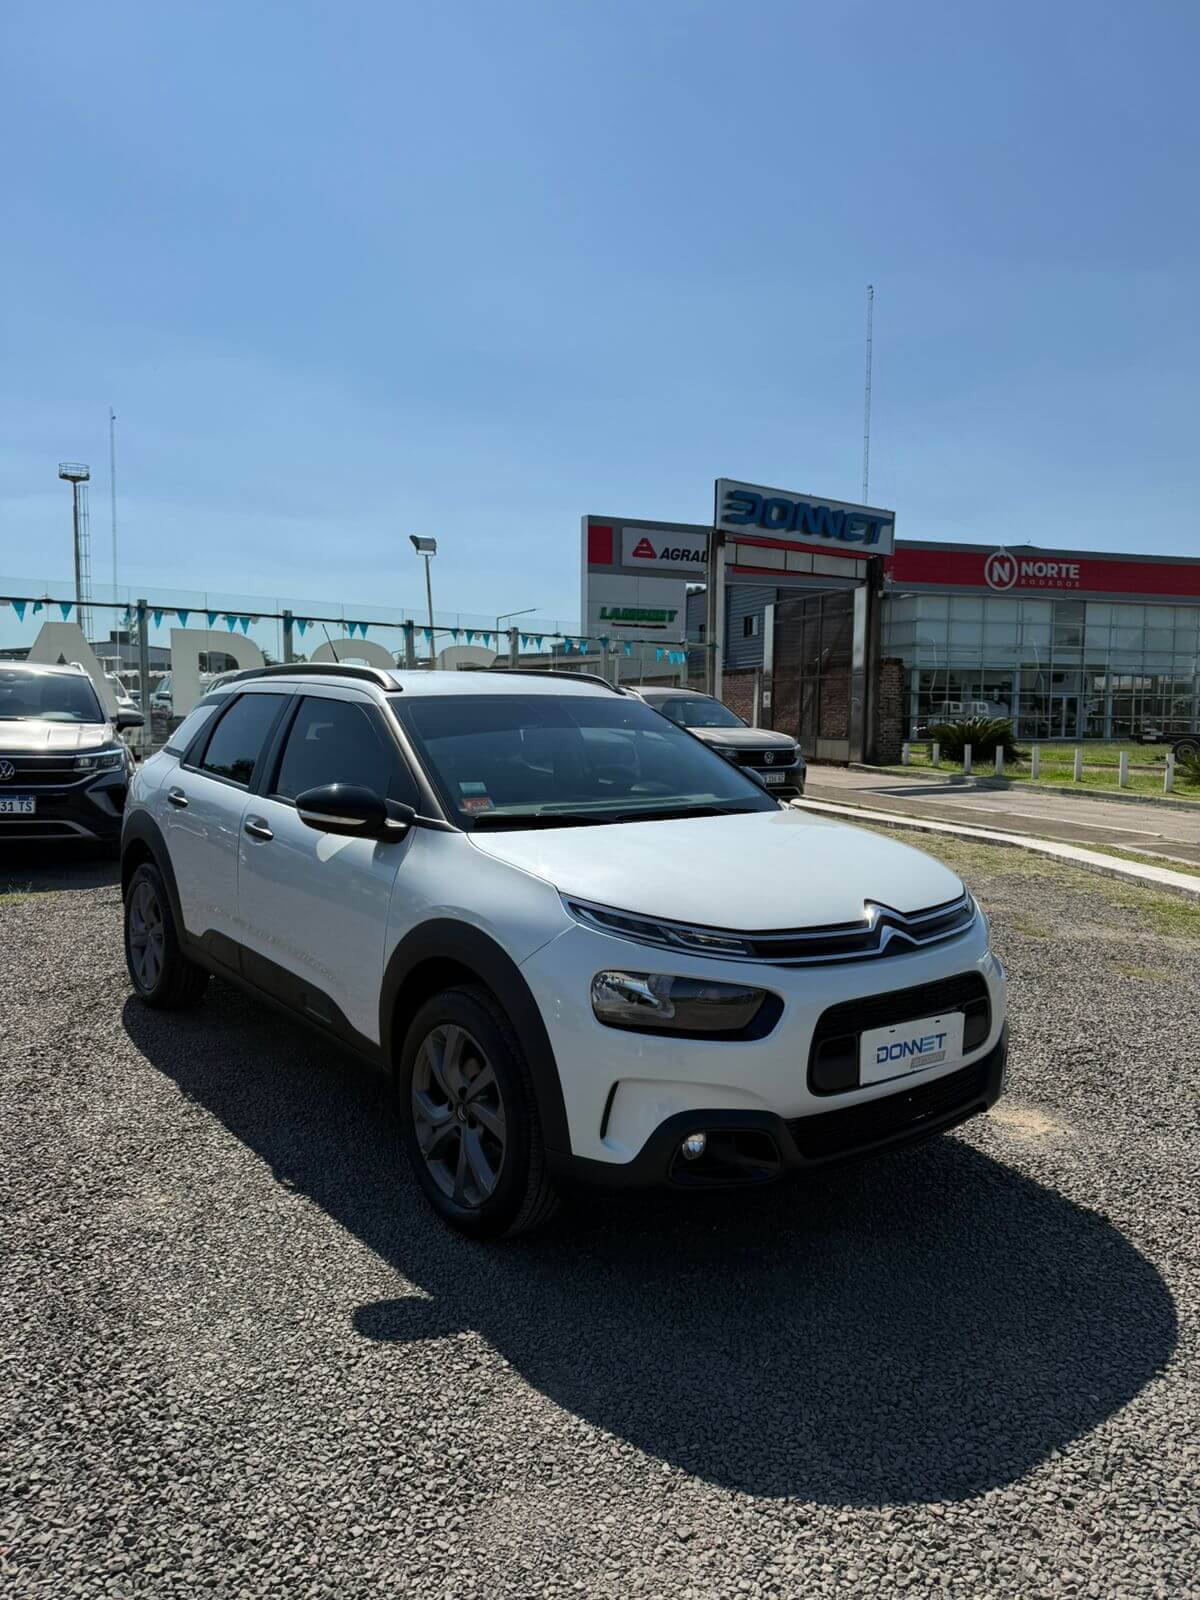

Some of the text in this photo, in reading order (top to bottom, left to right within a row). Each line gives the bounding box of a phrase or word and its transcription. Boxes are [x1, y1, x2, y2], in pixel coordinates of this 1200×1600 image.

[722, 489, 894, 545] DONNET
[659, 546, 708, 563] AGRAL
[1021, 561, 1080, 578] NORTE
[19, 801, 32, 812] TS
[877, 1032, 947, 1064] DONNET
